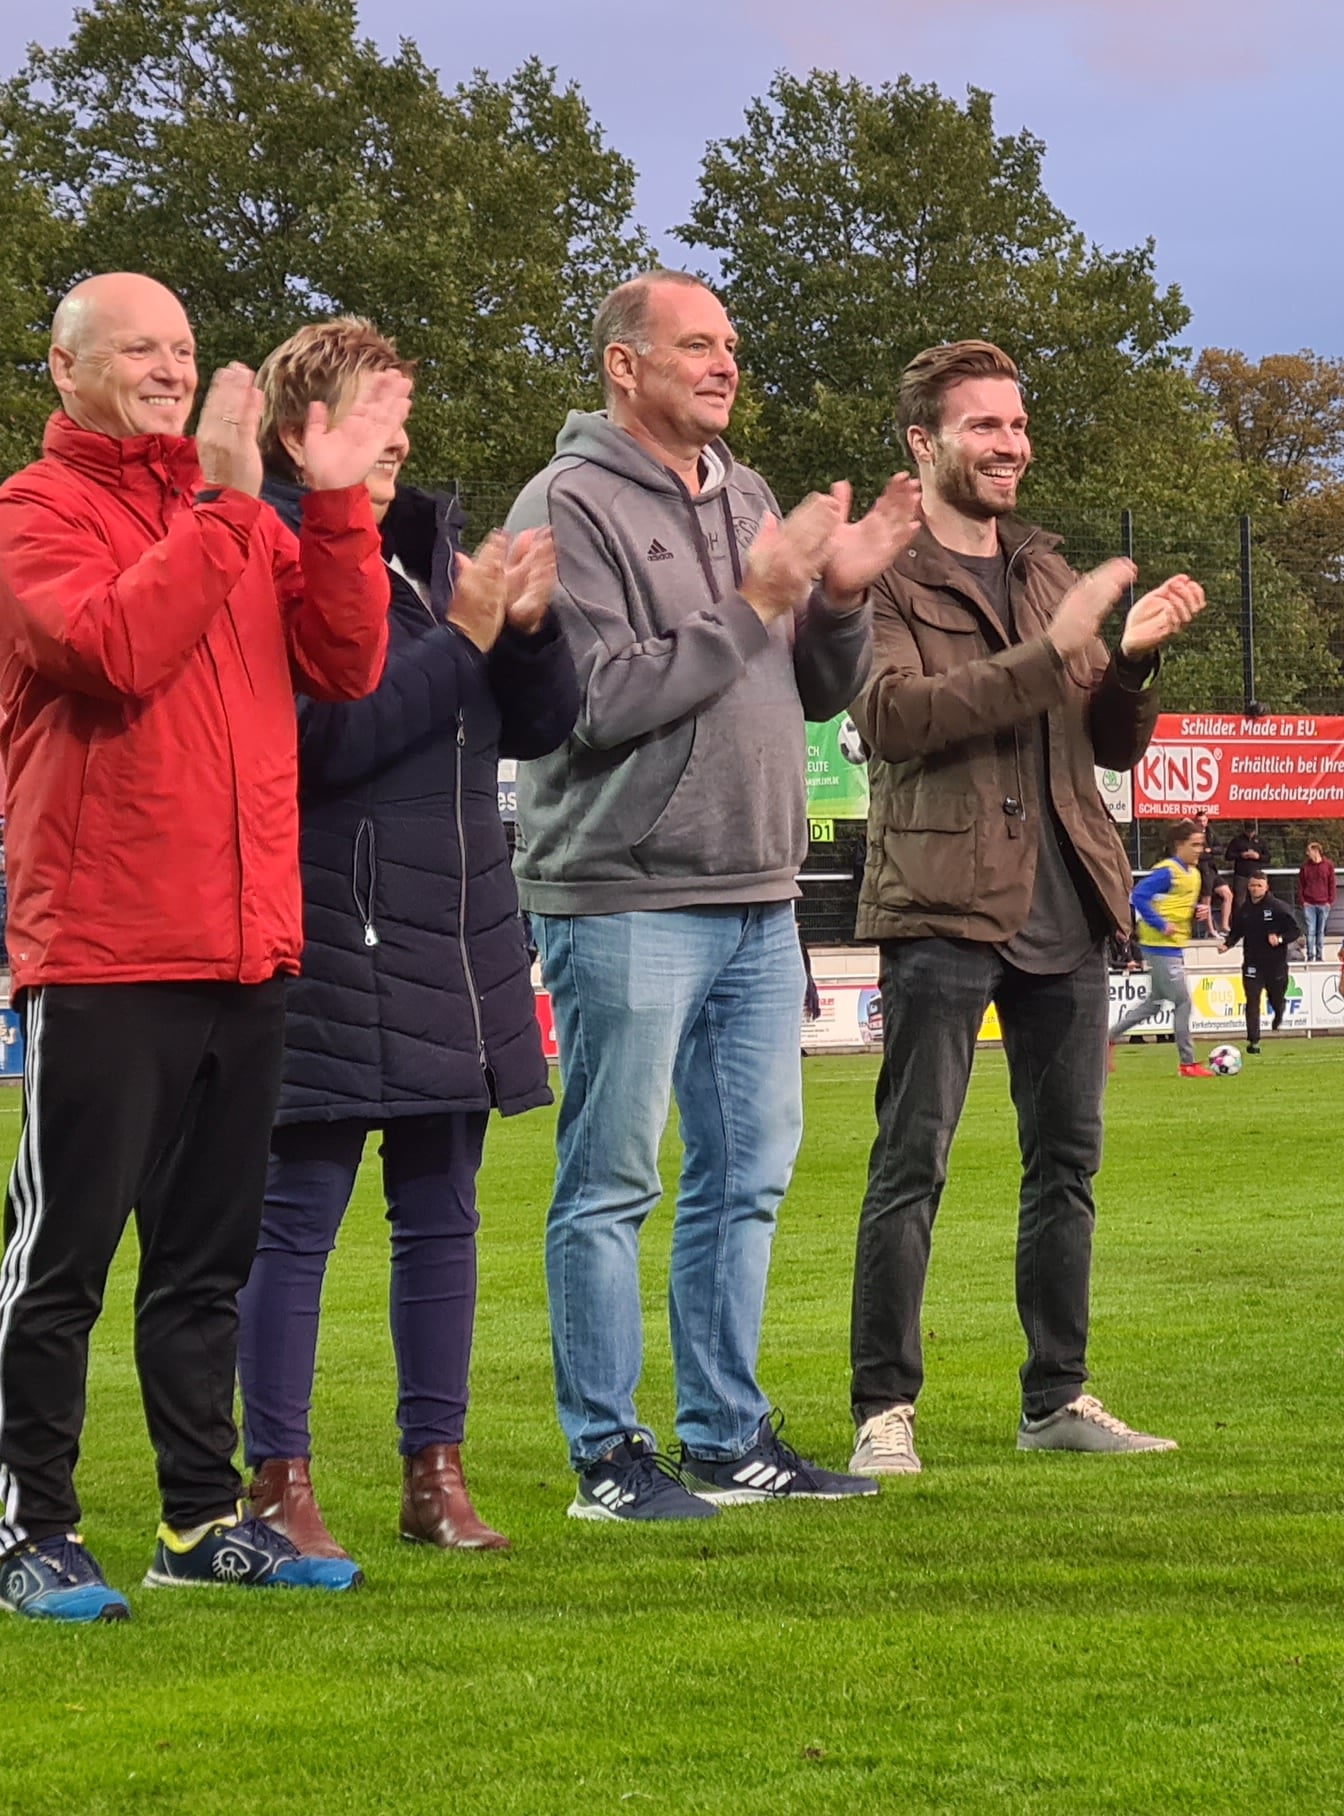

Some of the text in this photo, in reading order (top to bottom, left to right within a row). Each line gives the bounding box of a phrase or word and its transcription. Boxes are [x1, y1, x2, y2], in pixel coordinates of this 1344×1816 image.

[1181, 719, 1318, 737] Schilder. Made in EU.
[1142, 755, 1213, 793] KNS
[1231, 756, 1294, 774] Erhältlich
[1297, 757, 1317, 774] bei
[1138, 803, 1220, 815] SCHILDER SYSTEME
[812, 823, 831, 840] D1
